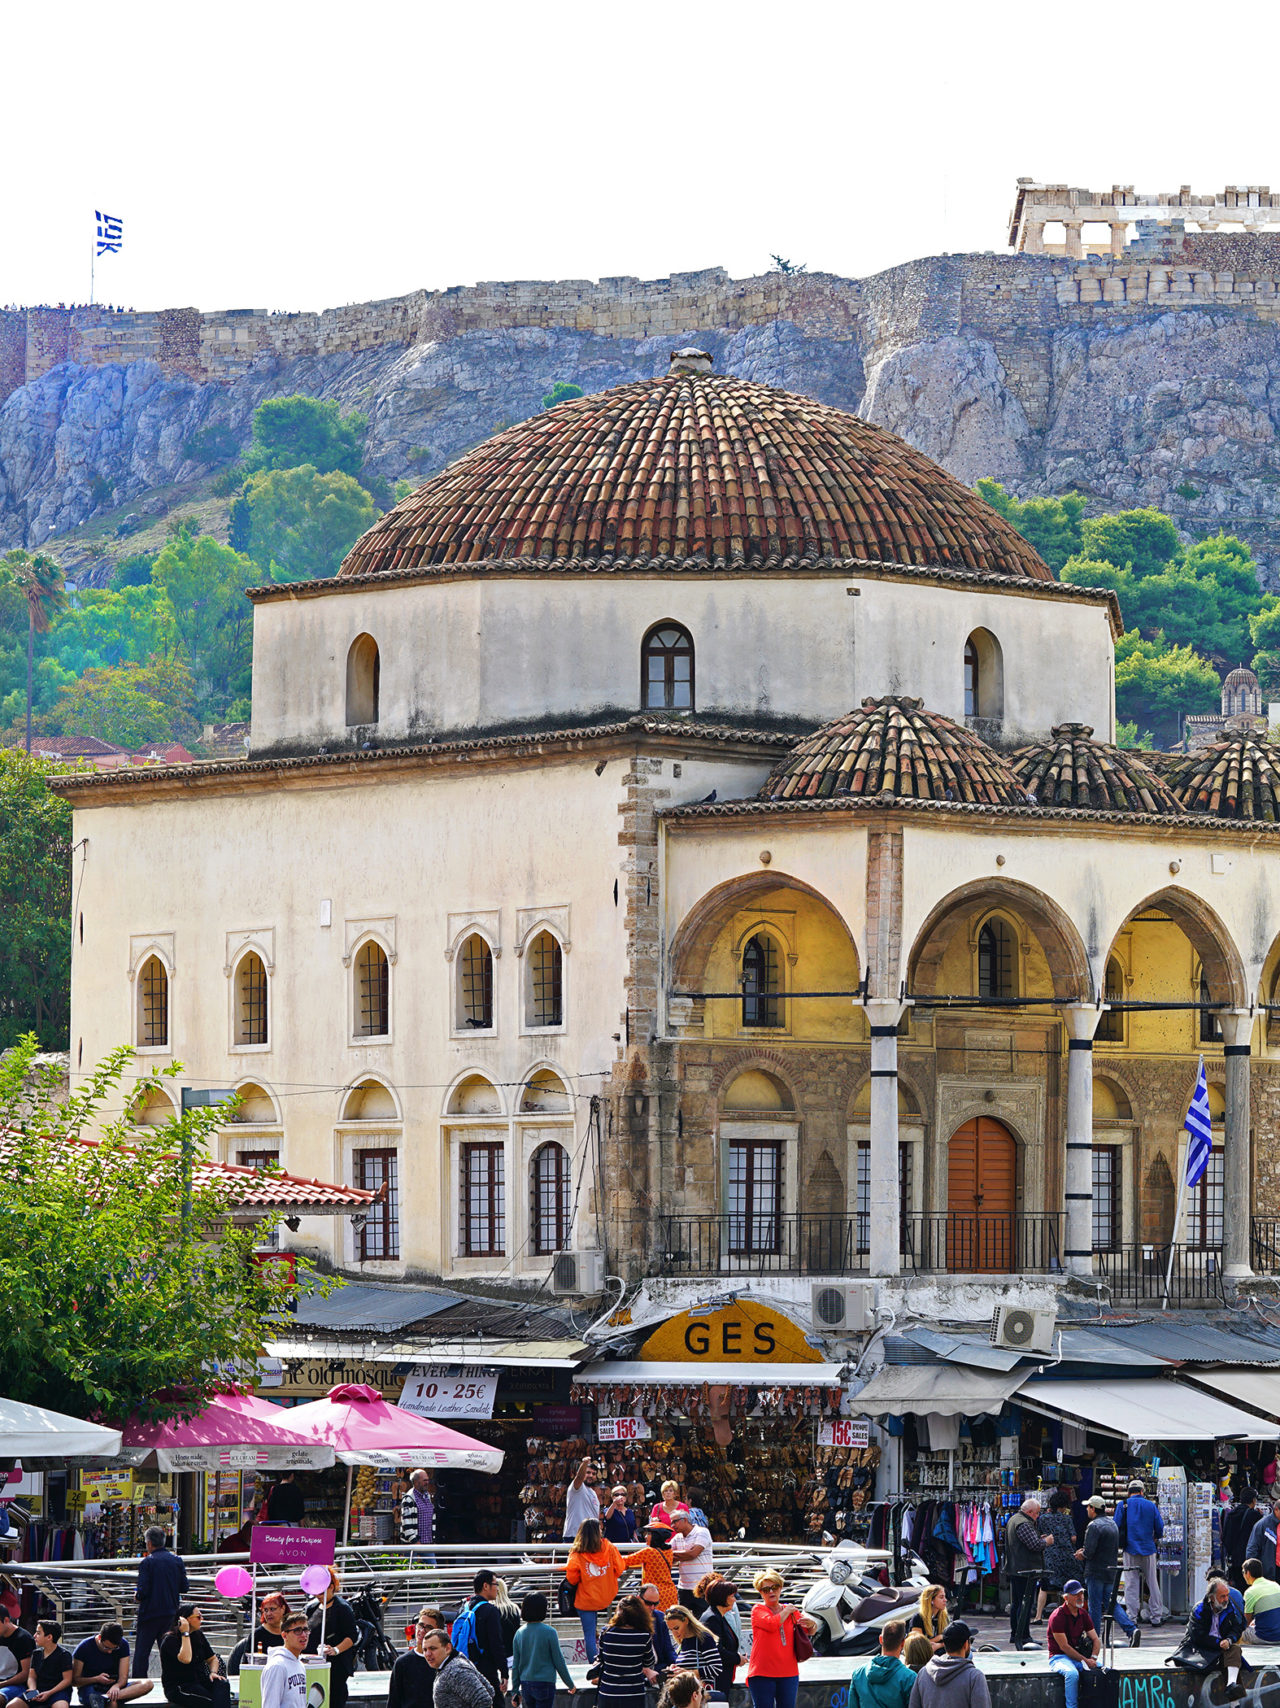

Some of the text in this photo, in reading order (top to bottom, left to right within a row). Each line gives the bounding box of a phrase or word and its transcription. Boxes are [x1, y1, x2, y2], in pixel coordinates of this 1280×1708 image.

[685, 1322, 775, 1355] GES
[411, 1365, 496, 1378] EVERTHING
[415, 1383, 438, 1399] 10
[452, 1383, 487, 1399] 25€
[399, 1401, 437, 1412] Handmade
[438, 1402, 463, 1414] Leather
[615, 1419, 637, 1439] 15€
[831, 1420, 852, 1446] 15€
[279, 1549, 307, 1557] AVON
